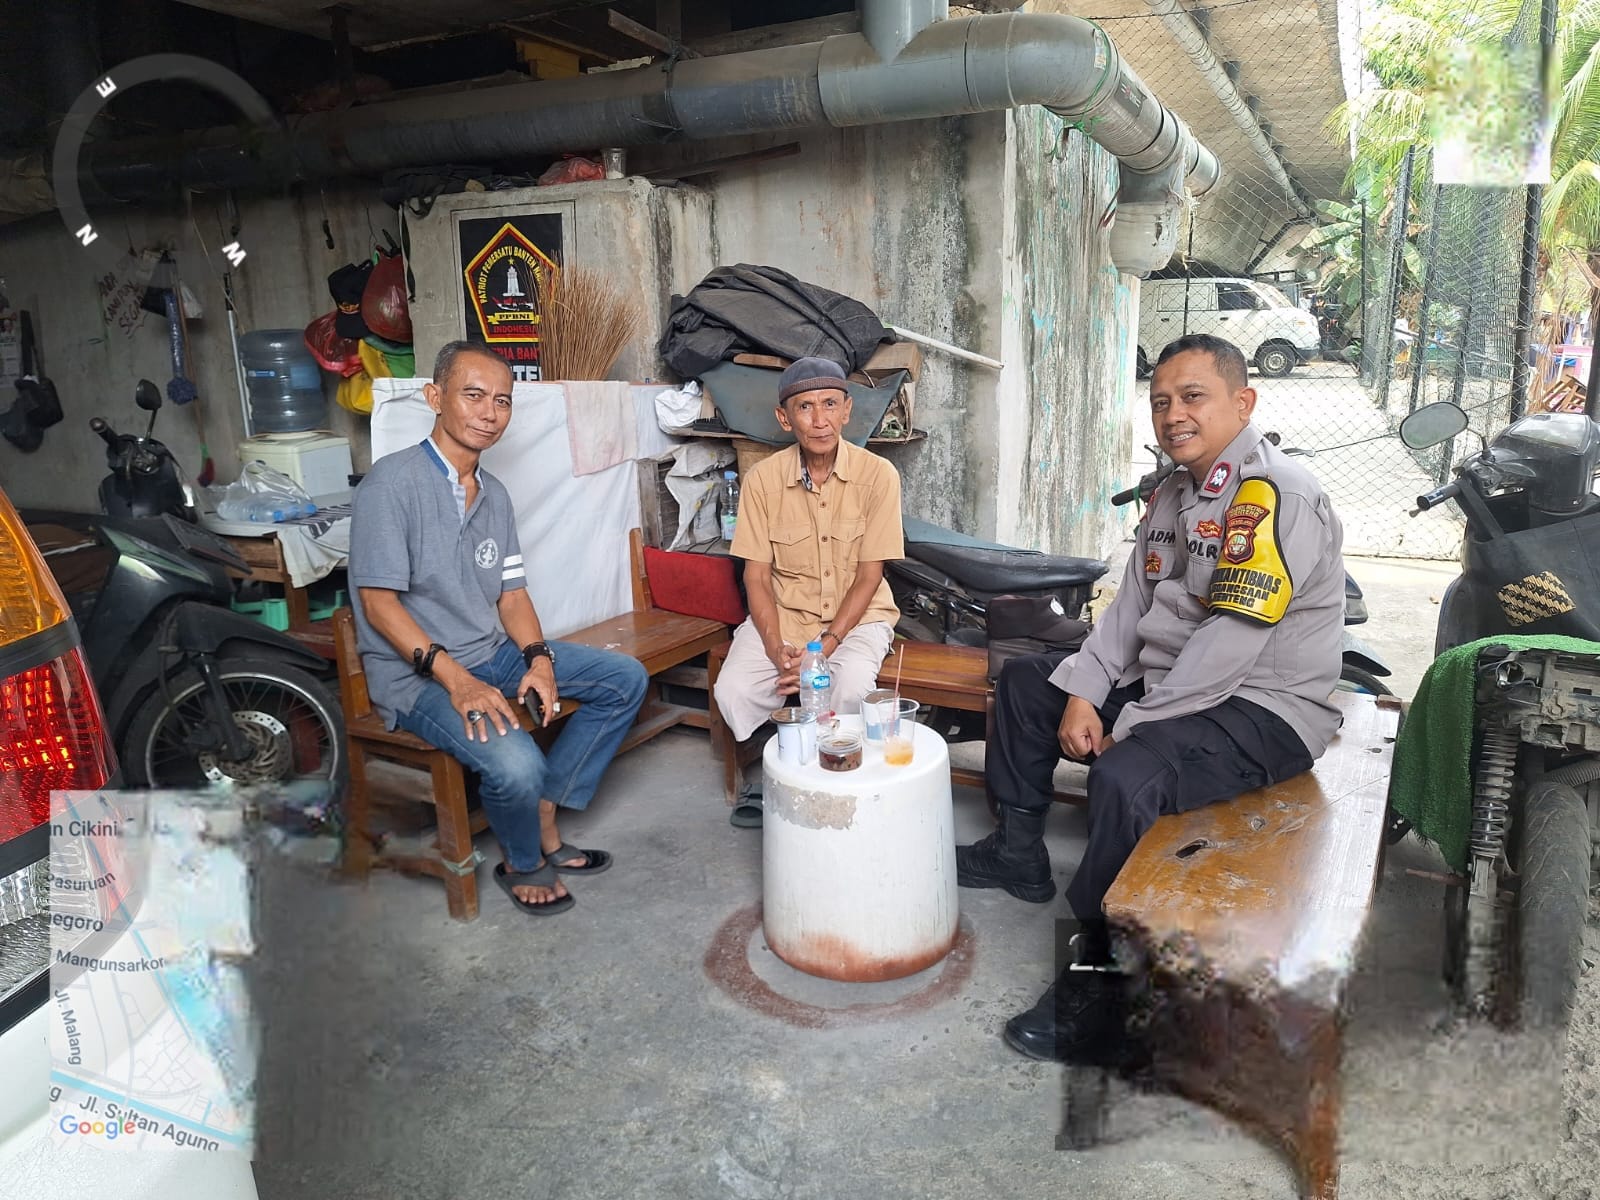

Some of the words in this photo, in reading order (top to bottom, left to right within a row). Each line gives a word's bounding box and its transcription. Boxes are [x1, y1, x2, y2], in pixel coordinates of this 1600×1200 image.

[482, 246, 513, 274] PEMERSATU
[513, 246, 538, 269] BANTEN
[478, 271, 489, 304] PATRIOT
[1185, 537, 1219, 559] OLR
